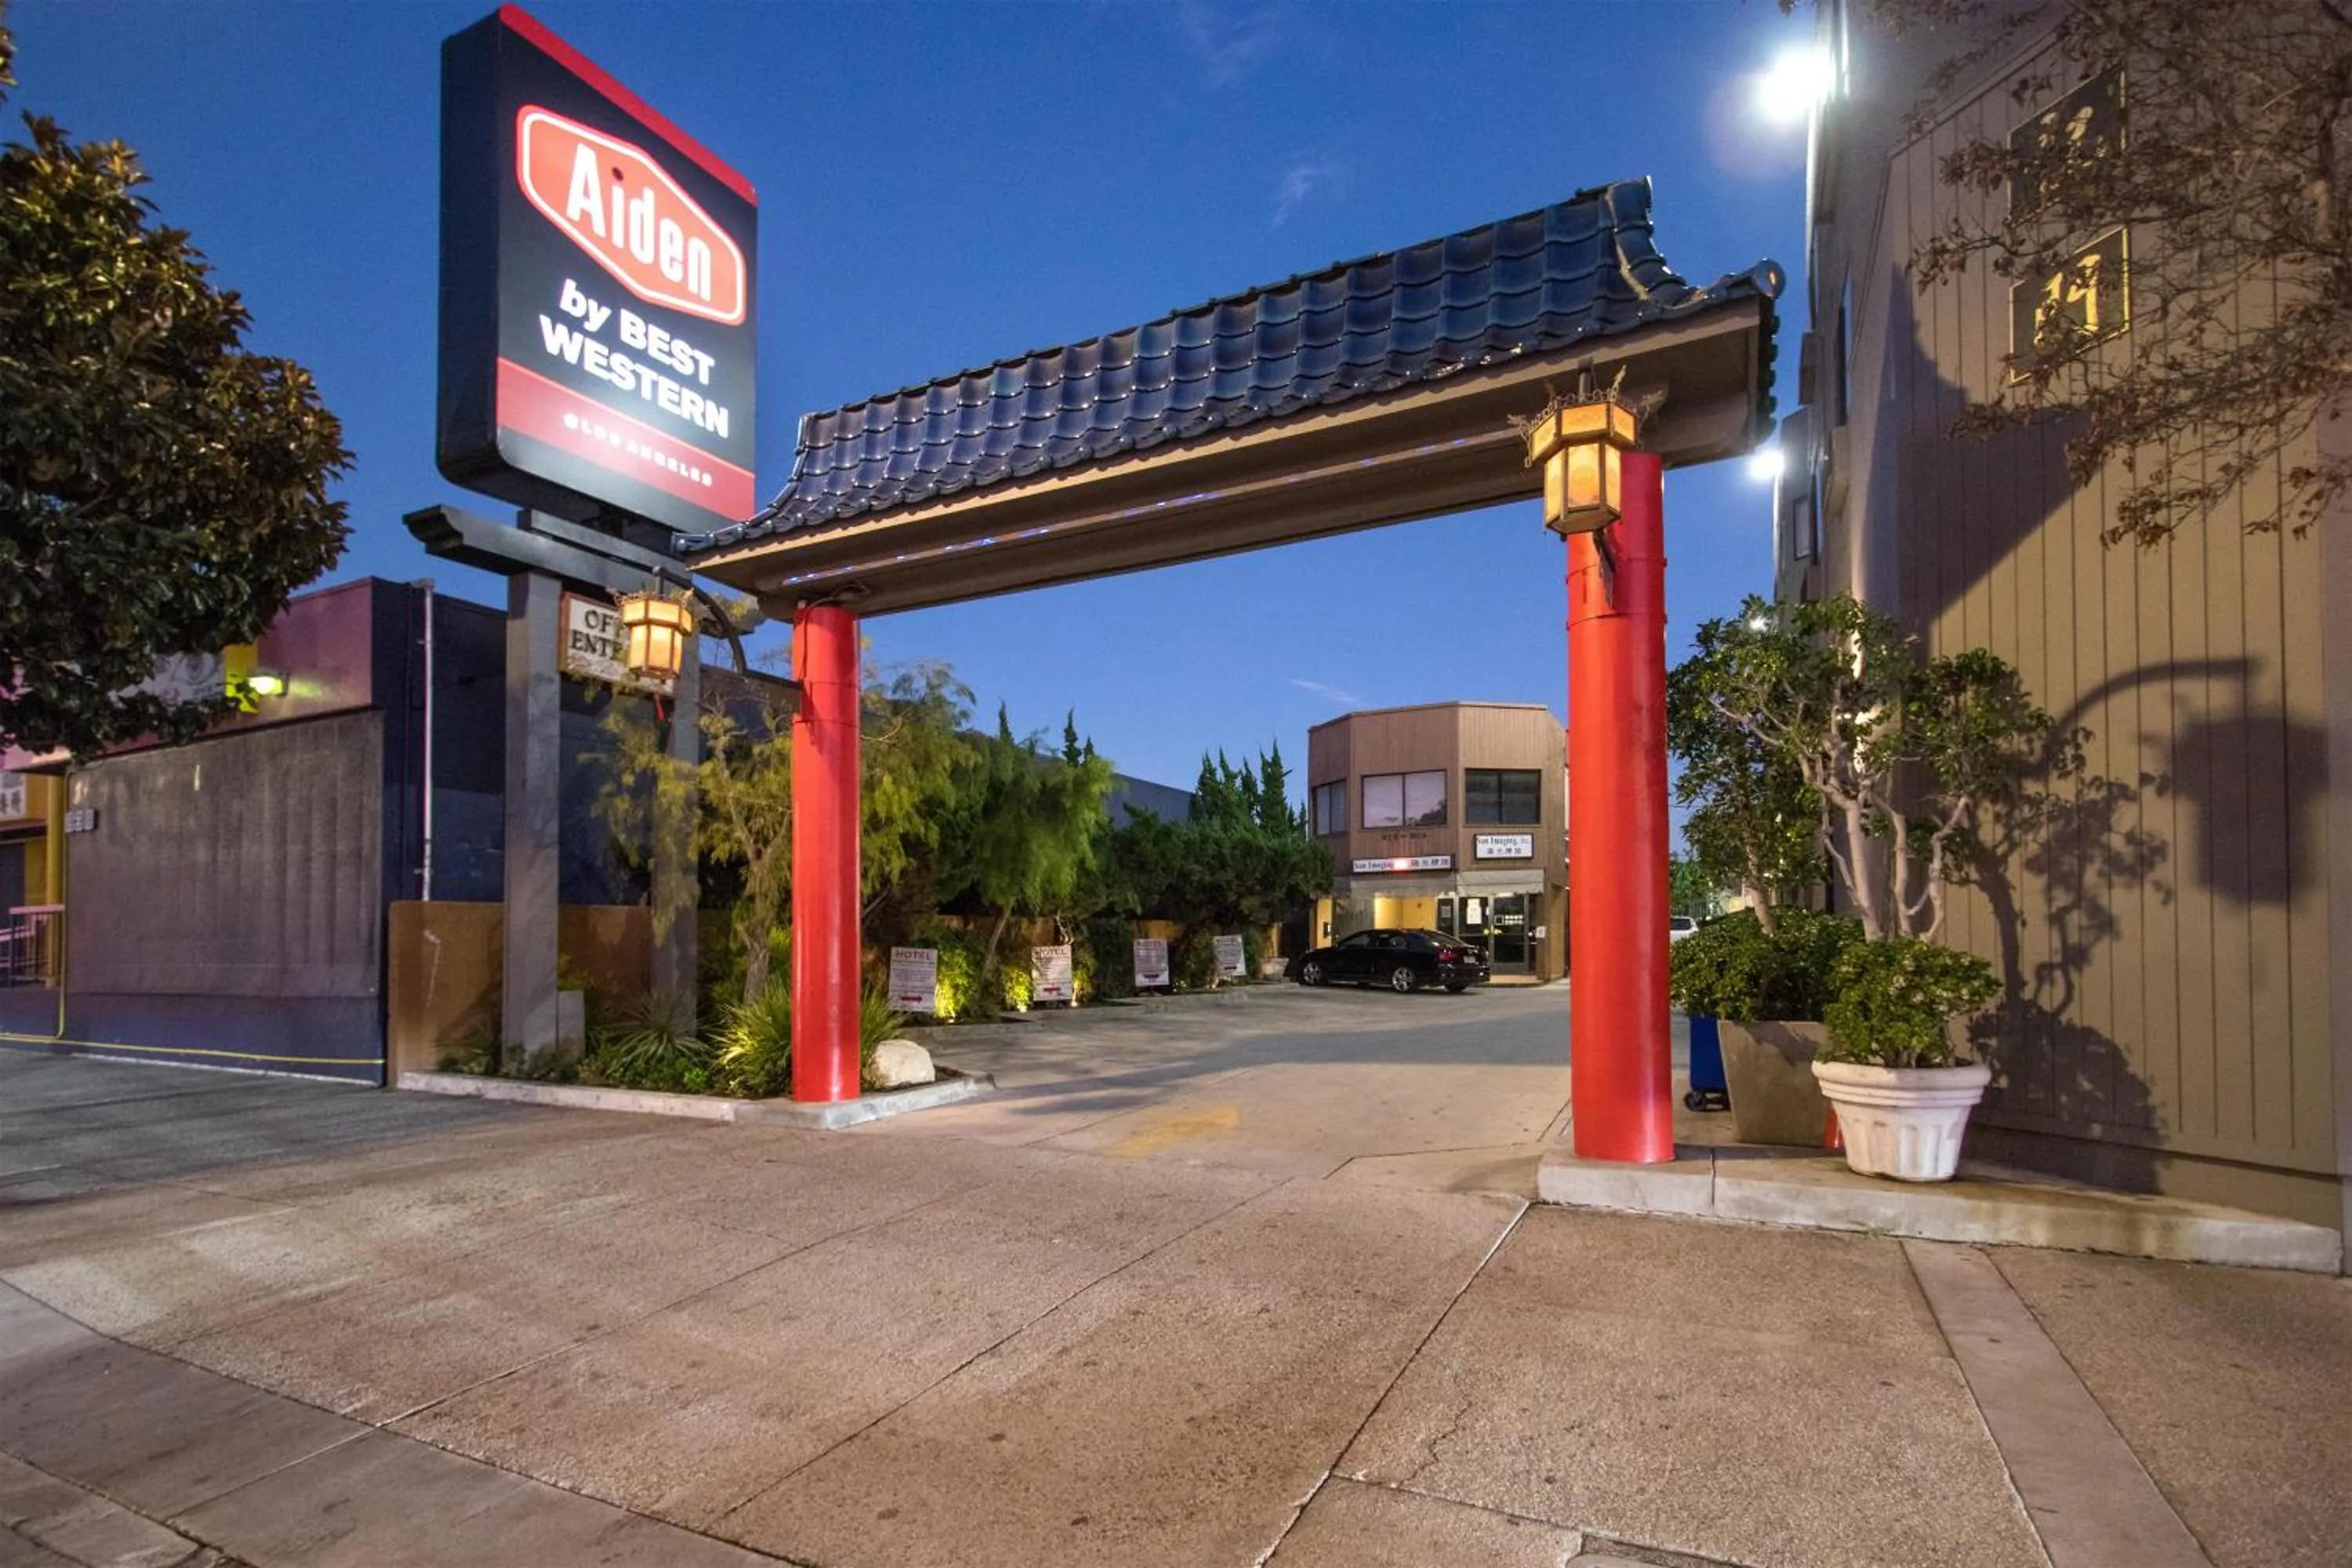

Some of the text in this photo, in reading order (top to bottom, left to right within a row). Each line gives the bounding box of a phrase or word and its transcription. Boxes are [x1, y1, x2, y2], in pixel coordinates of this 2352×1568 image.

[566, 143, 711, 301] Aiden
[539, 314, 728, 438] WESTERN
[560, 278, 715, 385] by BEST
[895, 949, 931, 960] HOTEL
